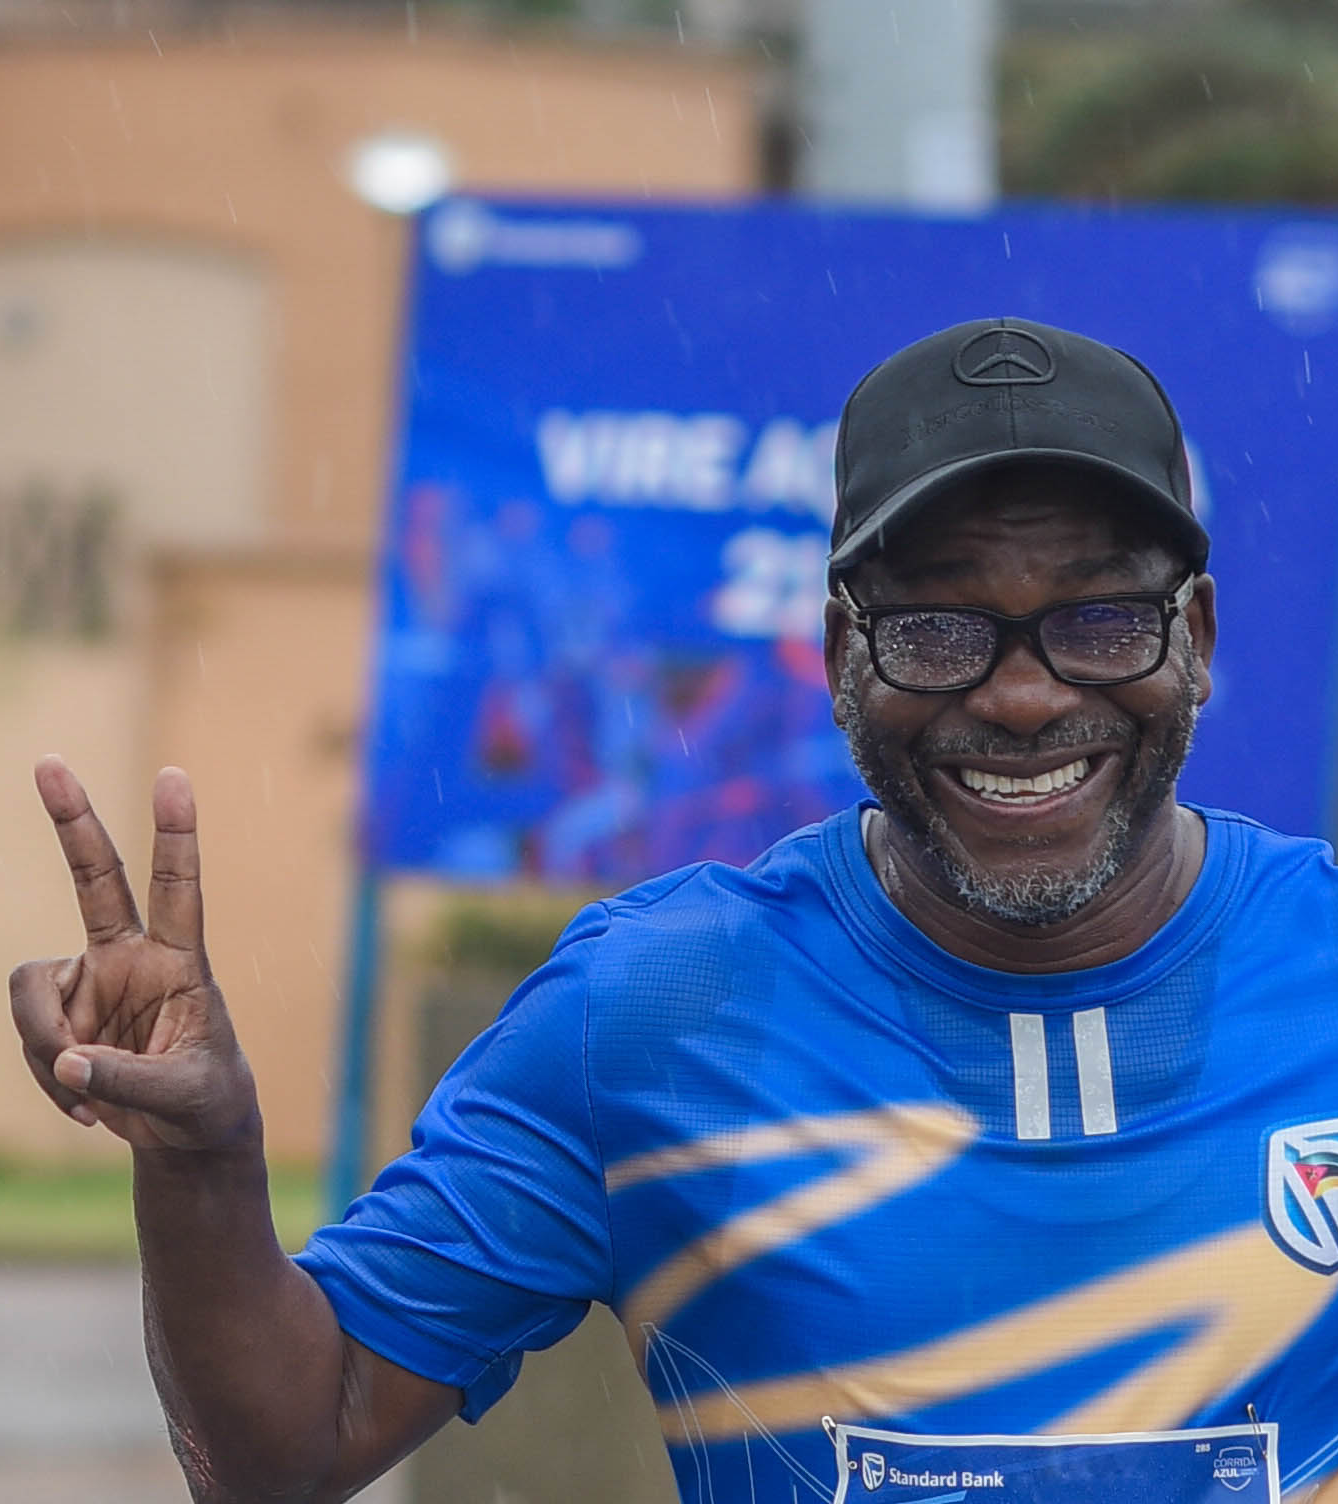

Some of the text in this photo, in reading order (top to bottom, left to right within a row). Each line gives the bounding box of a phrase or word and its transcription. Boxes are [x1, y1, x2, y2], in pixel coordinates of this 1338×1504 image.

[1213, 1457, 1257, 1469] CORRIDA
[889, 1467, 1004, 1488] Standard Bank
[1213, 1468, 1240, 1479] AZUL
